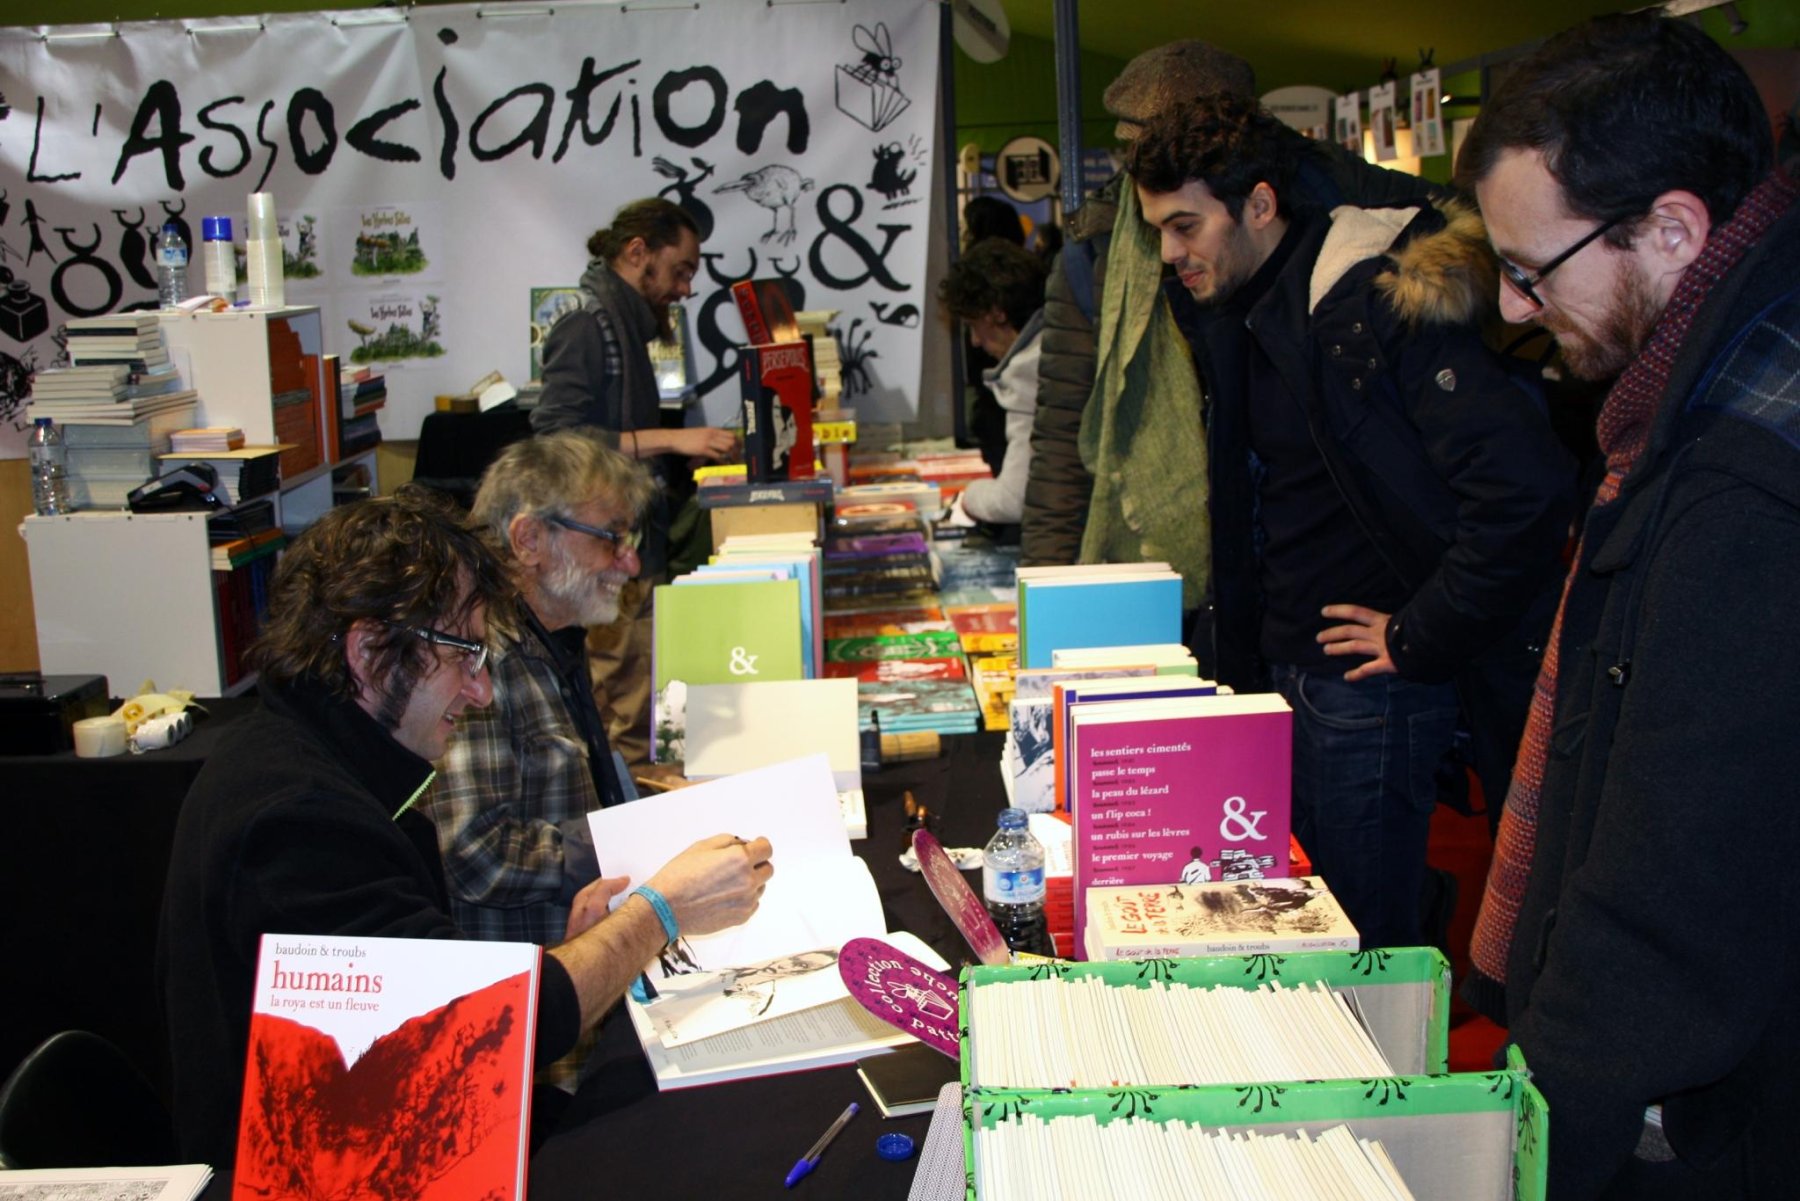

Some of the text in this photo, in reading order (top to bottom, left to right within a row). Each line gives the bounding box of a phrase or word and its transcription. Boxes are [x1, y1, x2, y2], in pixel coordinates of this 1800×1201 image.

[729, 646, 758, 675] &
[1091, 742, 1192, 758] les sentiers cimentés
[1091, 766, 1156, 780] passe le temps
[1091, 785, 1169, 800] la peau du lézard
[1091, 812, 1103, 820] un
[1105, 809, 1124, 821] flip
[1125, 810, 1146, 819] coca
[1219, 796, 1267, 842] &
[1091, 827, 1190, 841] un rubis sur les lèvres
[1092, 850, 1173, 864] le premier voyage
[275, 942, 366, 958] baudoin & troubs
[270, 959, 383, 994] humains
[270, 994, 380, 1012] la roya est un fleuve
